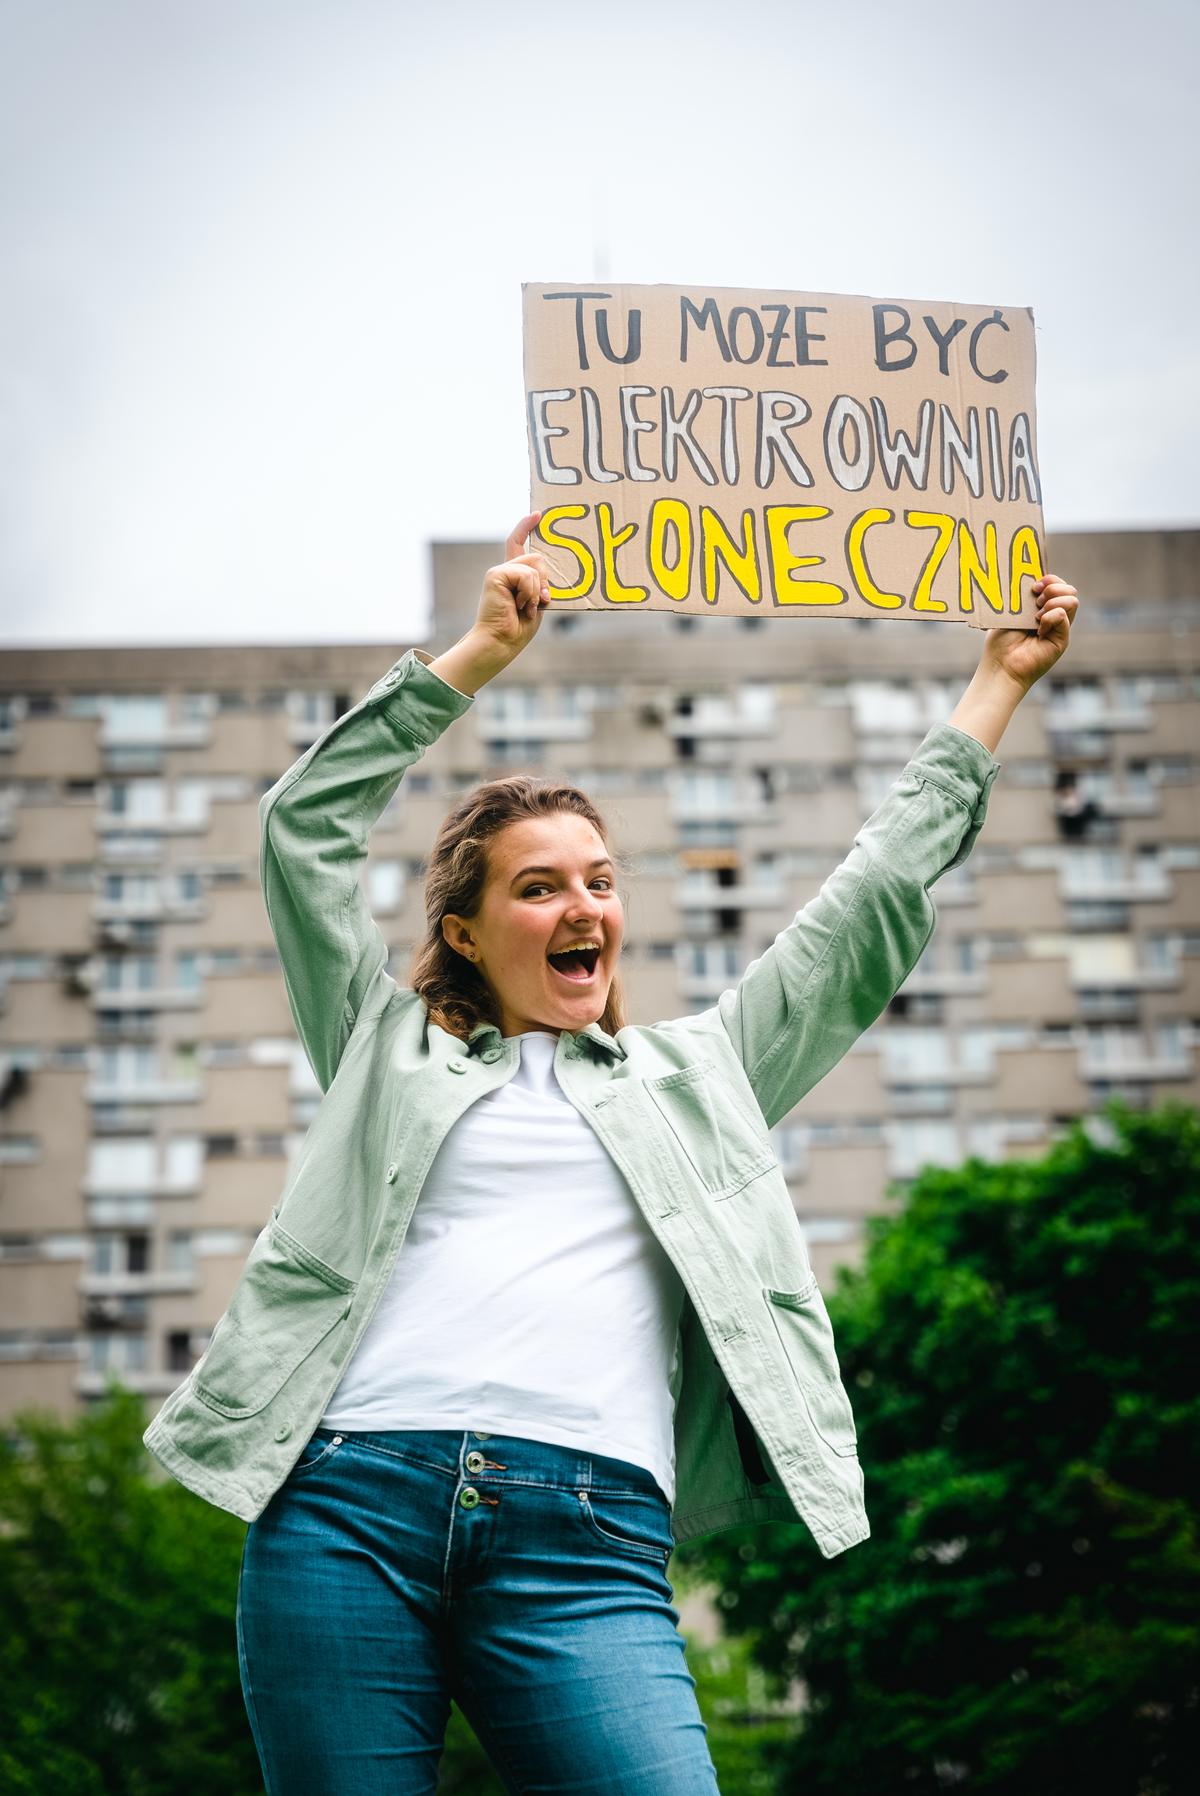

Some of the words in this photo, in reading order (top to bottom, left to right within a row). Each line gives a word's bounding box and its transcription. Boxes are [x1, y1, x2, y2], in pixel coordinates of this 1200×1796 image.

[543, 291, 641, 370] TU
[872, 304, 1010, 383] BYĆ
[528, 386, 1041, 504] ELEKTROWNIA
[536, 498, 1044, 615] SŁONECZNA
